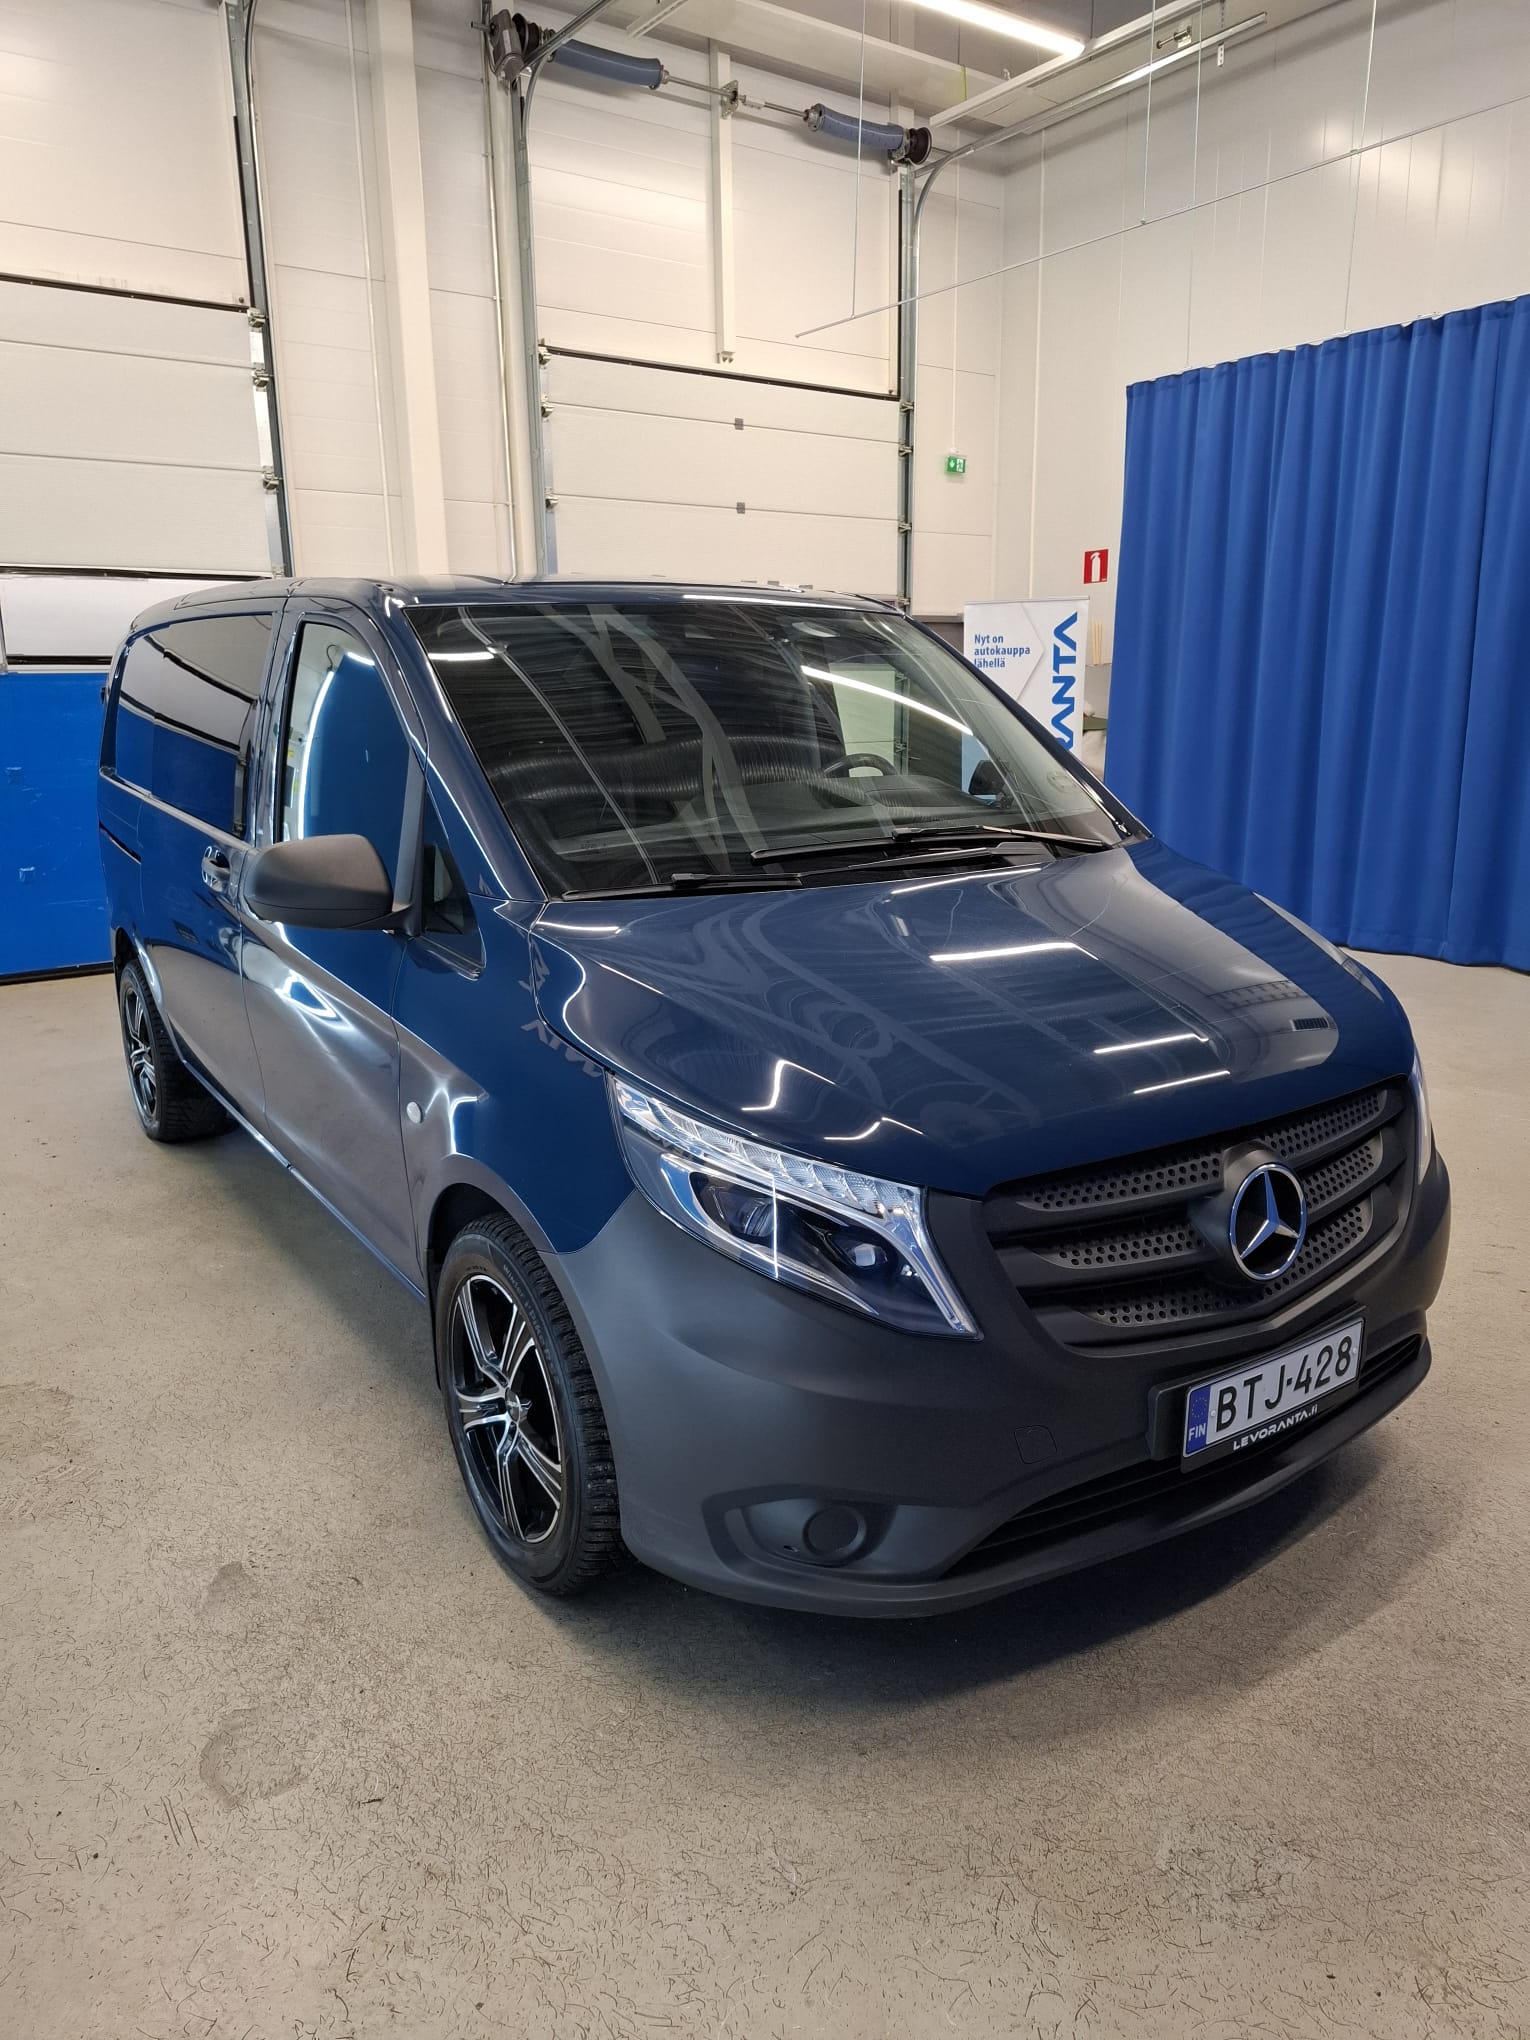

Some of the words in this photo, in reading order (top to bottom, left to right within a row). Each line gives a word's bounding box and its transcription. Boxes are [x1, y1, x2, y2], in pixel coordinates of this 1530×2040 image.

[974, 634, 990, 646] Nyt
[992, 636, 1004, 644] on
[974, 645, 1031, 657] autokauppa
[974, 658, 1006, 668] lähellä
[1216, 1335, 1352, 1433] BTJ-428
[1187, 1423, 1207, 1442] FIN
[1233, 1404, 1318, 1451] LEVORANTA.fi
